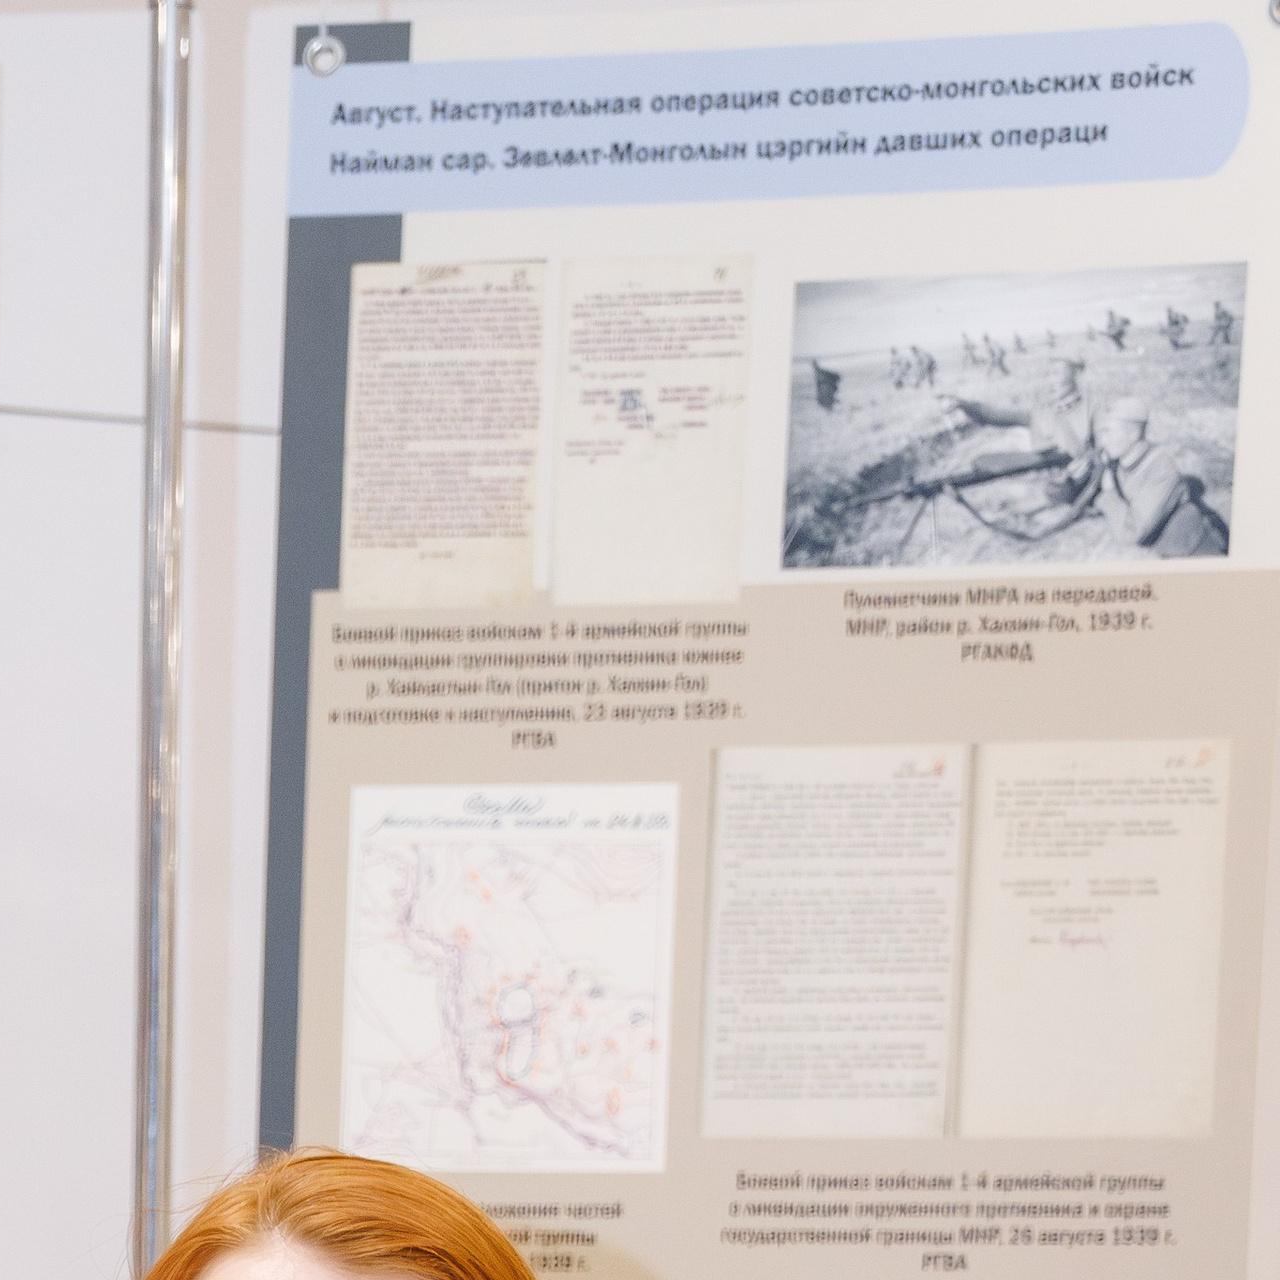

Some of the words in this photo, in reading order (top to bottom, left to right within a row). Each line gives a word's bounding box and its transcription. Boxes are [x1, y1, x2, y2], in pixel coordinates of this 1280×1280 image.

[332, 102, 423, 129] Август.
[429, 96, 642, 125] Наступательная
[650, 90, 780, 115] операция
[788, 74, 1102, 107] советско-монгольских
[1110, 63, 1196, 91] войск
[329, 149, 434, 175] Найман
[441, 151, 495, 176] сар.
[756, 131, 867, 162] цэргийн
[874, 131, 982, 155] давших
[990, 124, 1108, 151] операци
